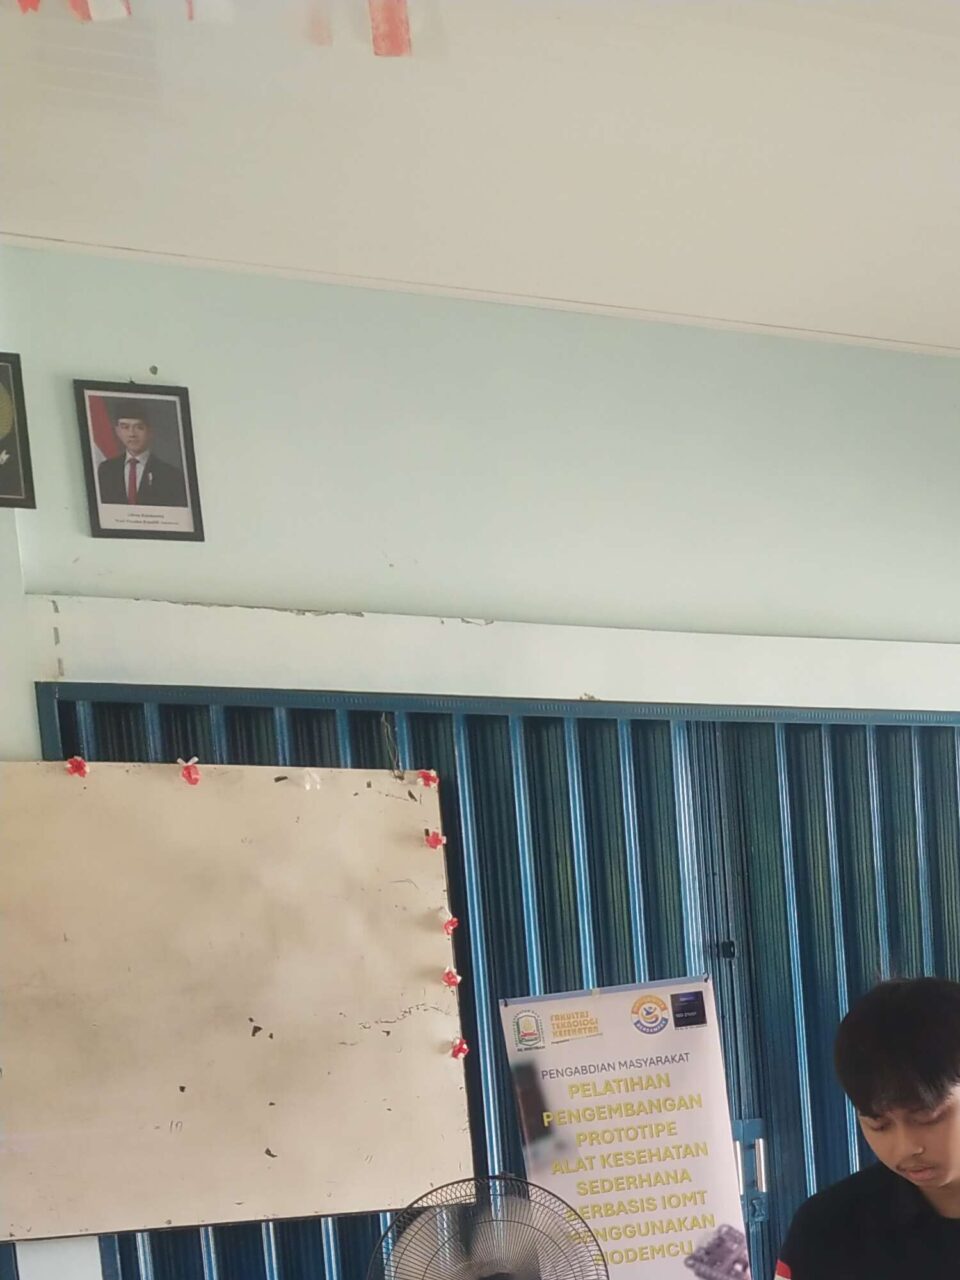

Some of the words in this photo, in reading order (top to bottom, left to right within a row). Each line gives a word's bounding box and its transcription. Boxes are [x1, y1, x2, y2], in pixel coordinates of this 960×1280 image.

[541, 1061, 617, 1080] PENGABDIAN
[618, 1052, 690, 1070] MASYARAKAT
[568, 1073, 670, 1099] PELATIHAN
[543, 1094, 703, 1127] PENGEMBANGAN
[576, 1121, 678, 1147] PROTOTIPE
[551, 1155, 597, 1175] ALAT
[600, 1142, 709, 1169] KESEHATAN
[576, 1168, 692, 1196] SEDERHANA
[661, 1190, 708, 1209] IOMT
